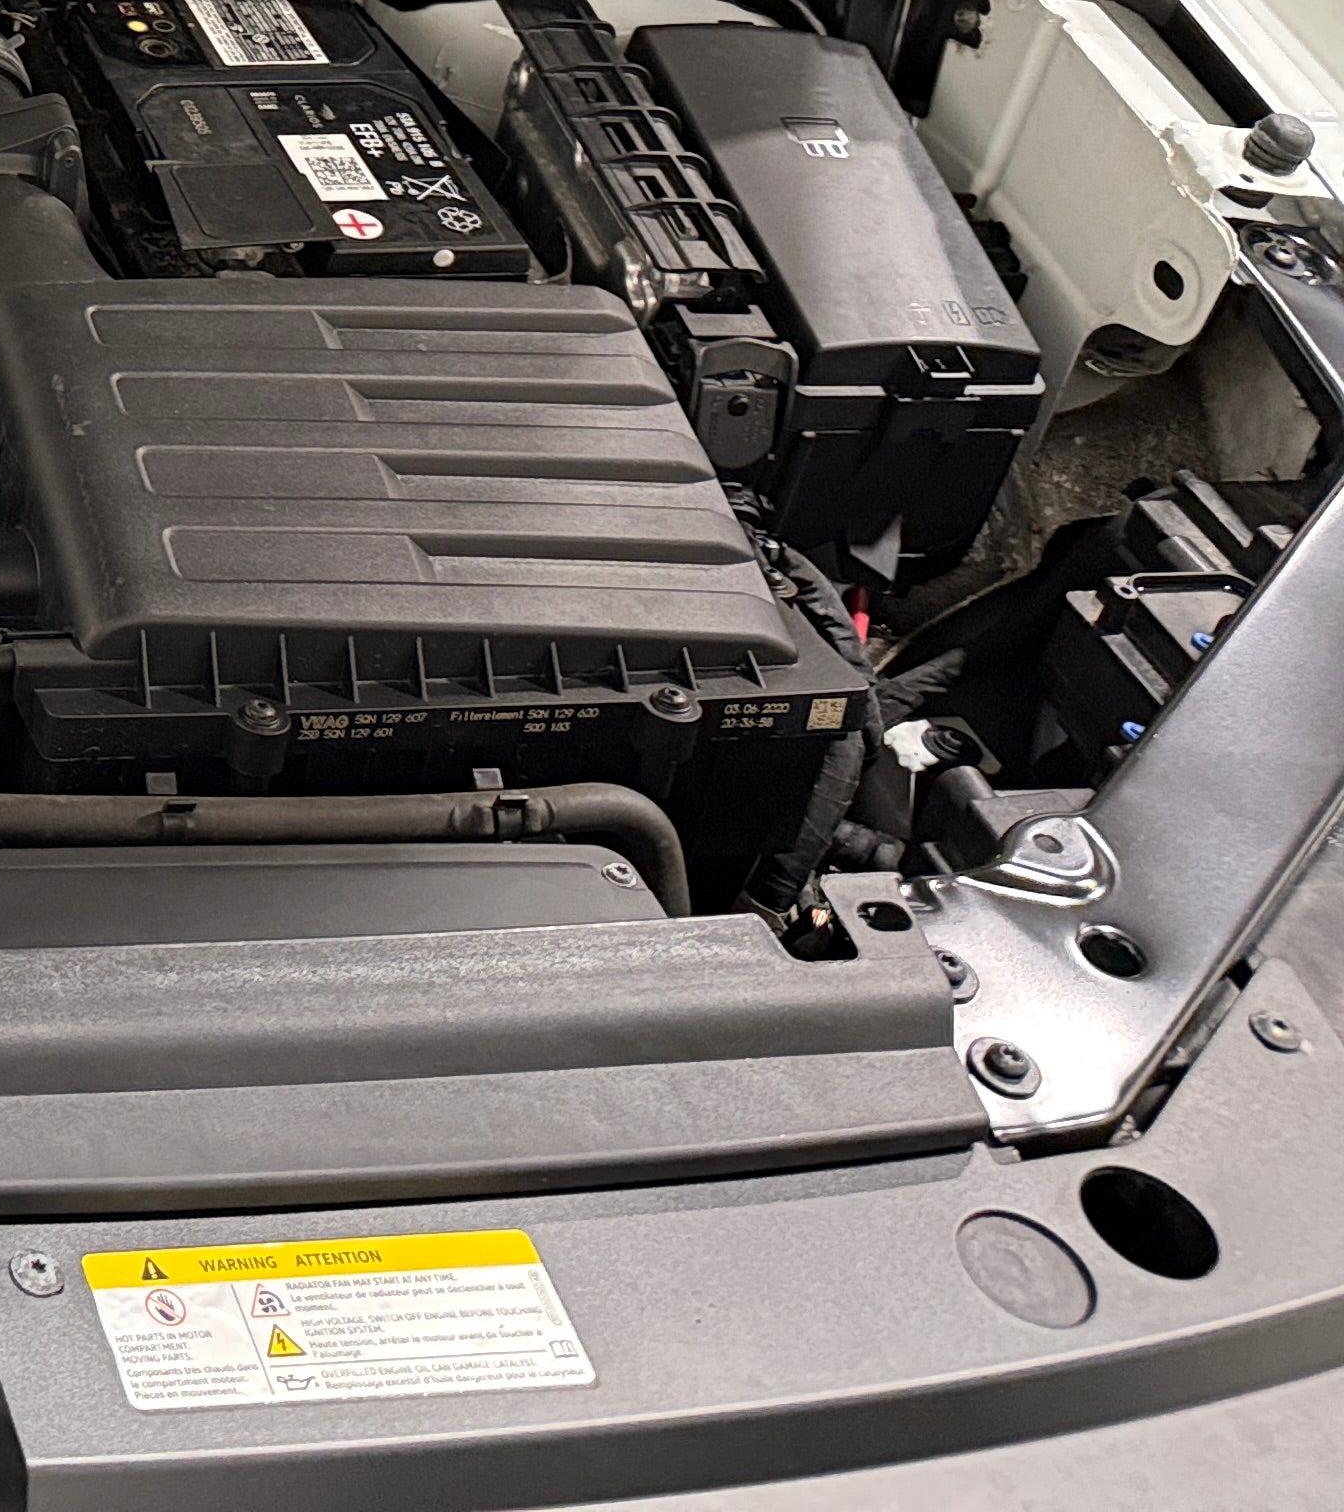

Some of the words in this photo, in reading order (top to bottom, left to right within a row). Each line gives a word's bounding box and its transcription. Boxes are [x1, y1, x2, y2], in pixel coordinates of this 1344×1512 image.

[349, 123, 386, 158] EFB+
[198, 1255, 278, 1273] WARNING
[295, 1249, 383, 1267] ATTENTION
[285, 1280, 331, 1291] RADIATOR
[332, 1279, 351, 1288] FAN
[353, 1277, 371, 1287] MAY
[373, 1276, 400, 1285] START
[402, 1275, 412, 1284] AT
[414, 1274, 432, 1284] ANY
[291, 1293, 302, 1303] Le
[369, 1287, 410, 1298] radiateur
[412, 1287, 434, 1297] peut
[115, 1334, 134, 1343] HOT
[136, 1332, 165, 1342] PARTS
[166, 1332, 177, 1340] IN
[179, 1330, 213, 1340] MOTOR
[304, 1326, 347, 1337] IGNITION
[308, 1339, 338, 1349] Haute
[121, 1353, 161, 1364] MOVING
[126, 1366, 184, 1378] Composants
[142, 1376, 209, 1389] compartiment
